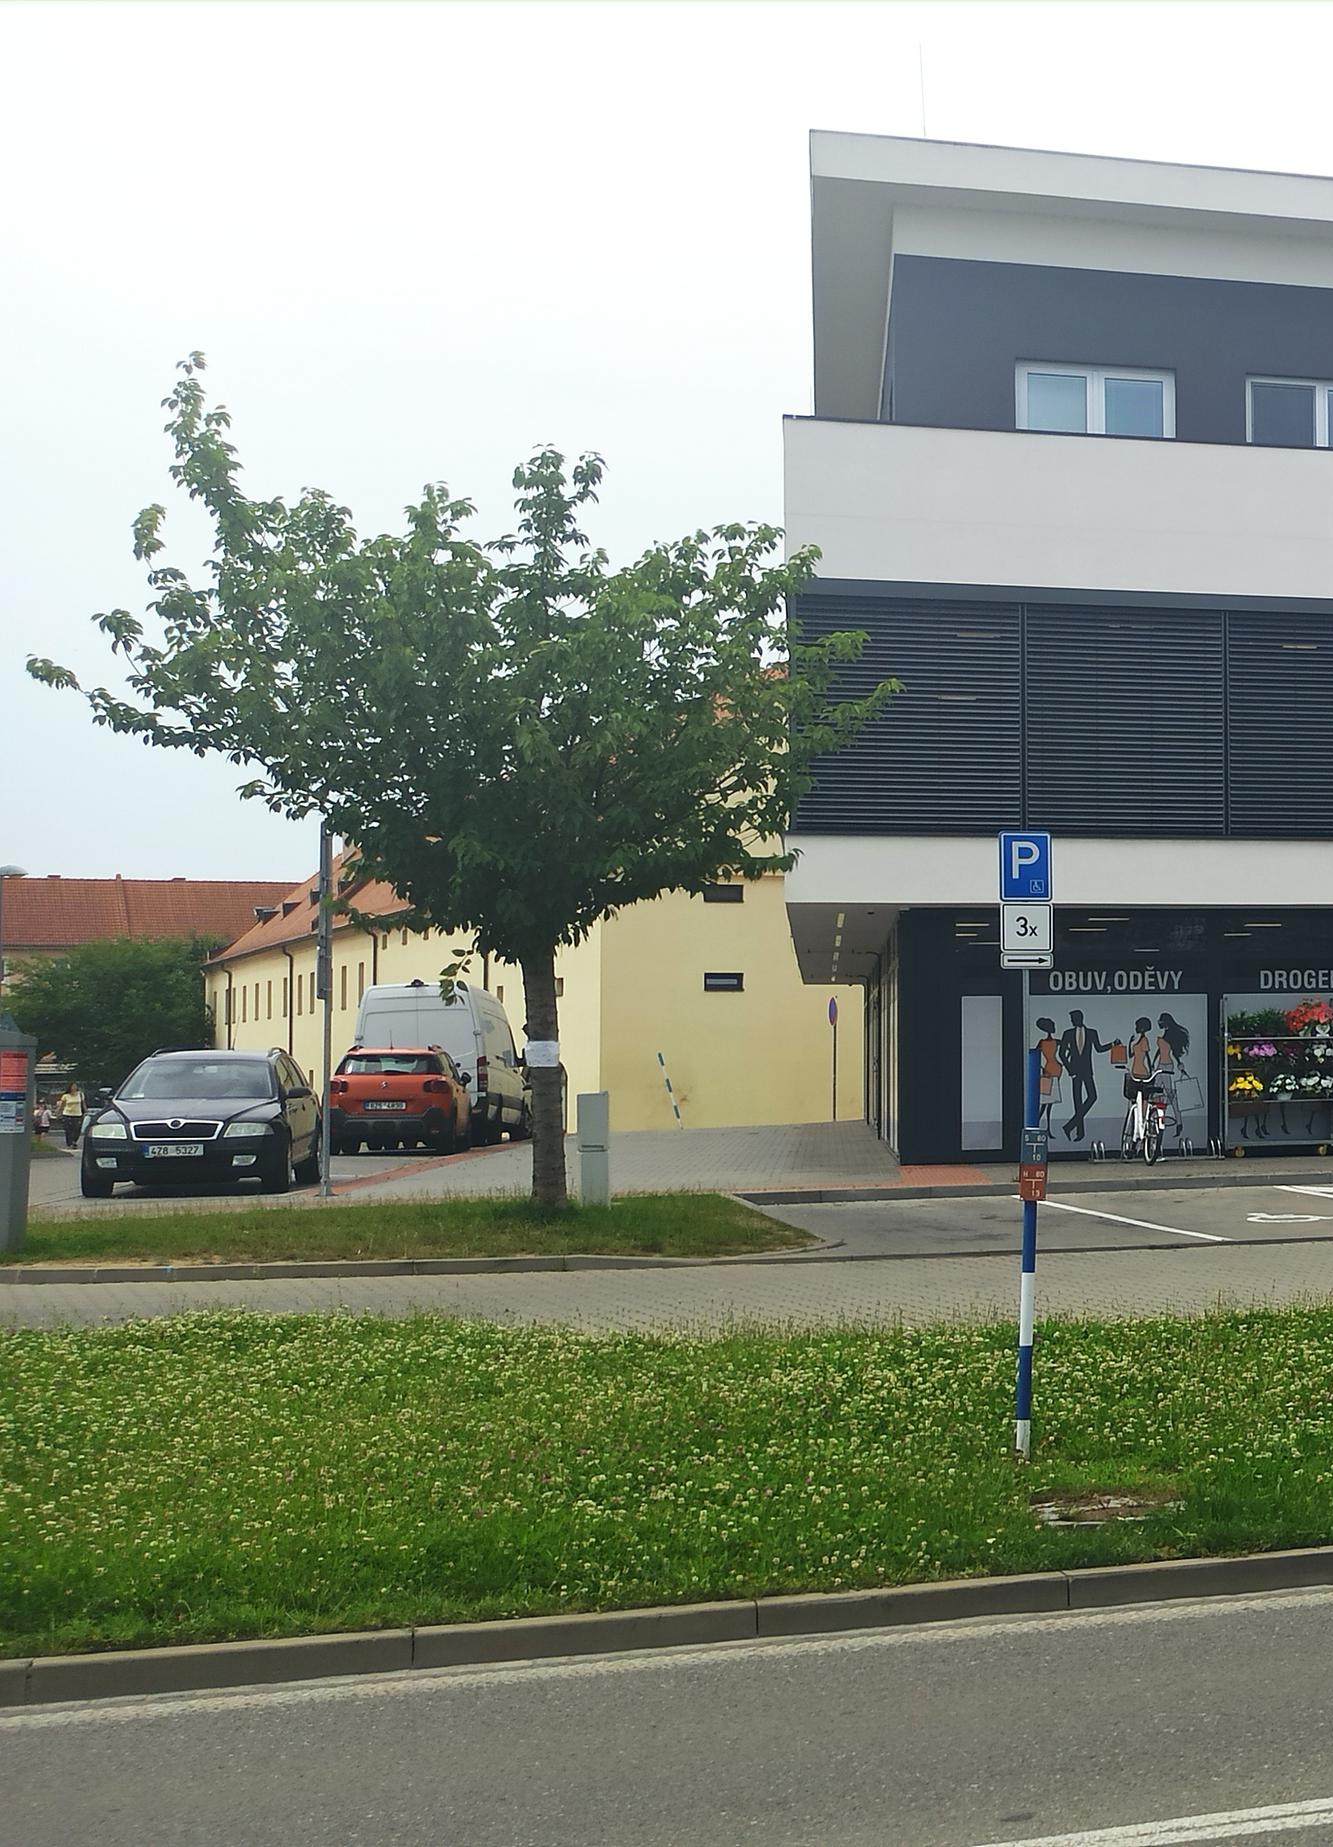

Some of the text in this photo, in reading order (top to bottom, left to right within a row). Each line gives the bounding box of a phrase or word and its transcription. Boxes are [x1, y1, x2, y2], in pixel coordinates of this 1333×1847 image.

[1011, 841, 1040, 879] P
[1015, 916, 1038, 937] 3x
[151, 1145, 200, 1156] 4Z8 5327
